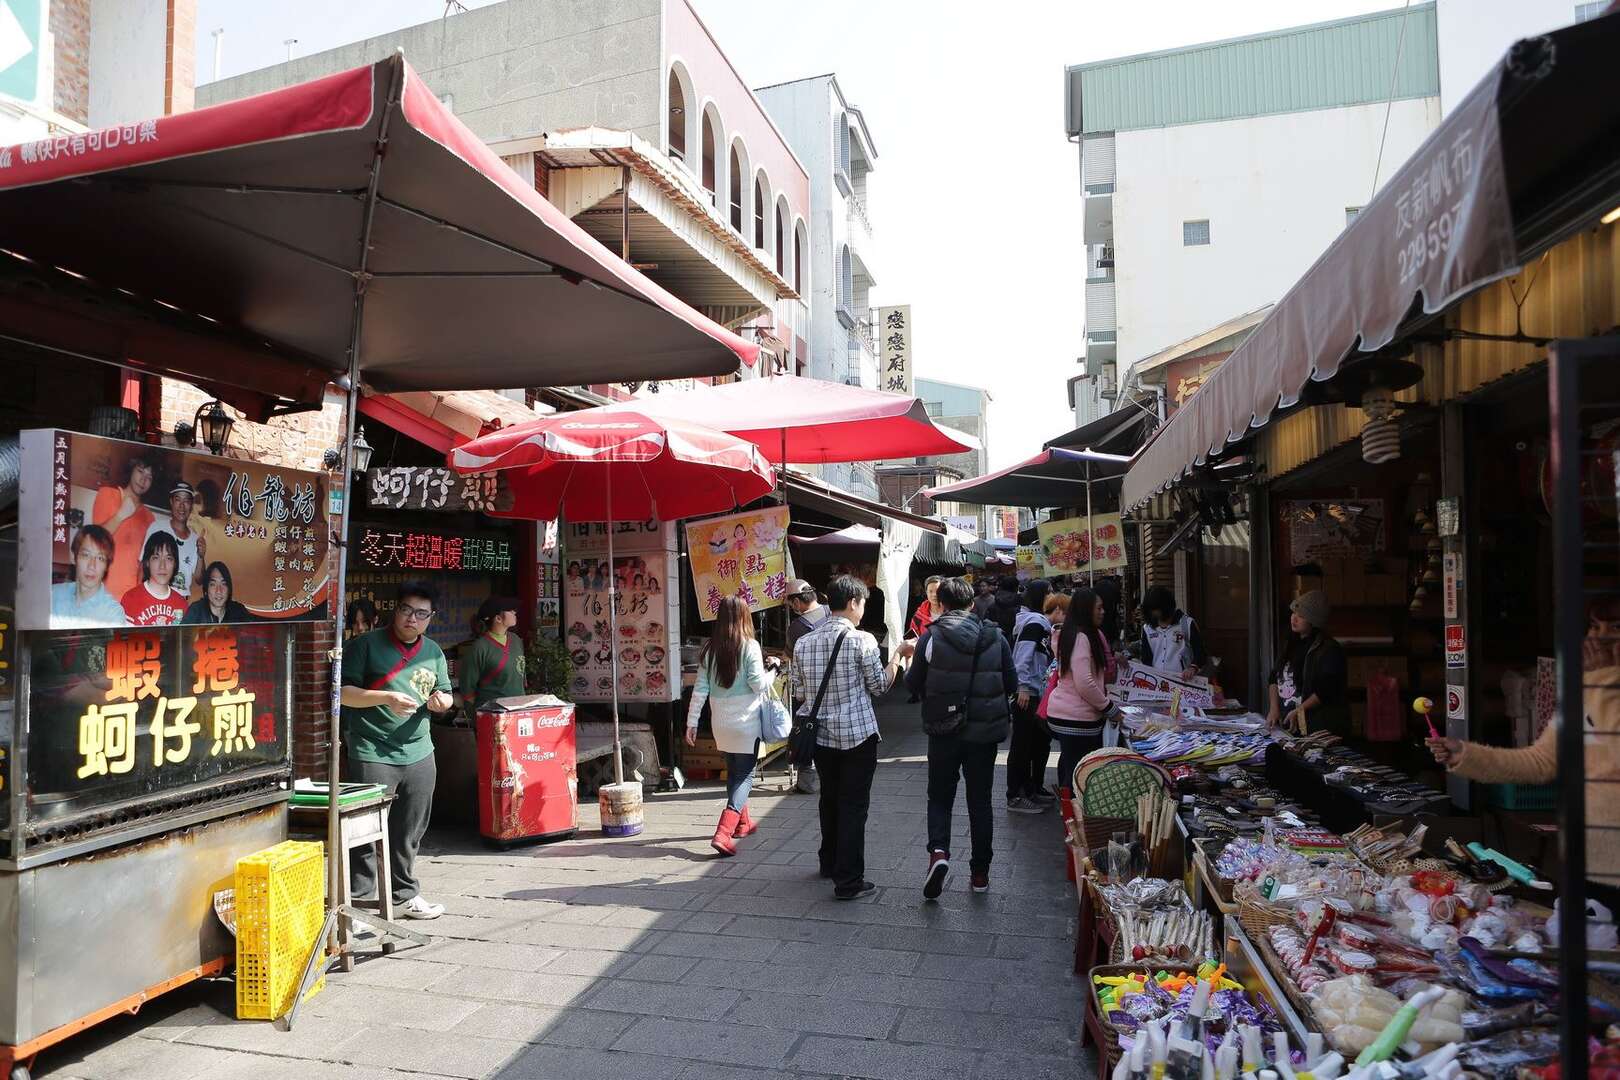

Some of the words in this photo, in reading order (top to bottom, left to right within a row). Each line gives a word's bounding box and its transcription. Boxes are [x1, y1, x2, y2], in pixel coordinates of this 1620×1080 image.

[886, 310, 908, 393] 戀戀府城
[54, 437, 68, 543] 五月天熱力推薦
[223, 472, 316, 523] 伯龍坊
[275, 526, 316, 541] 蚵仔煎
[717, 553, 767, 581] 御點
[76, 689, 256, 779] 蚵仔煎
